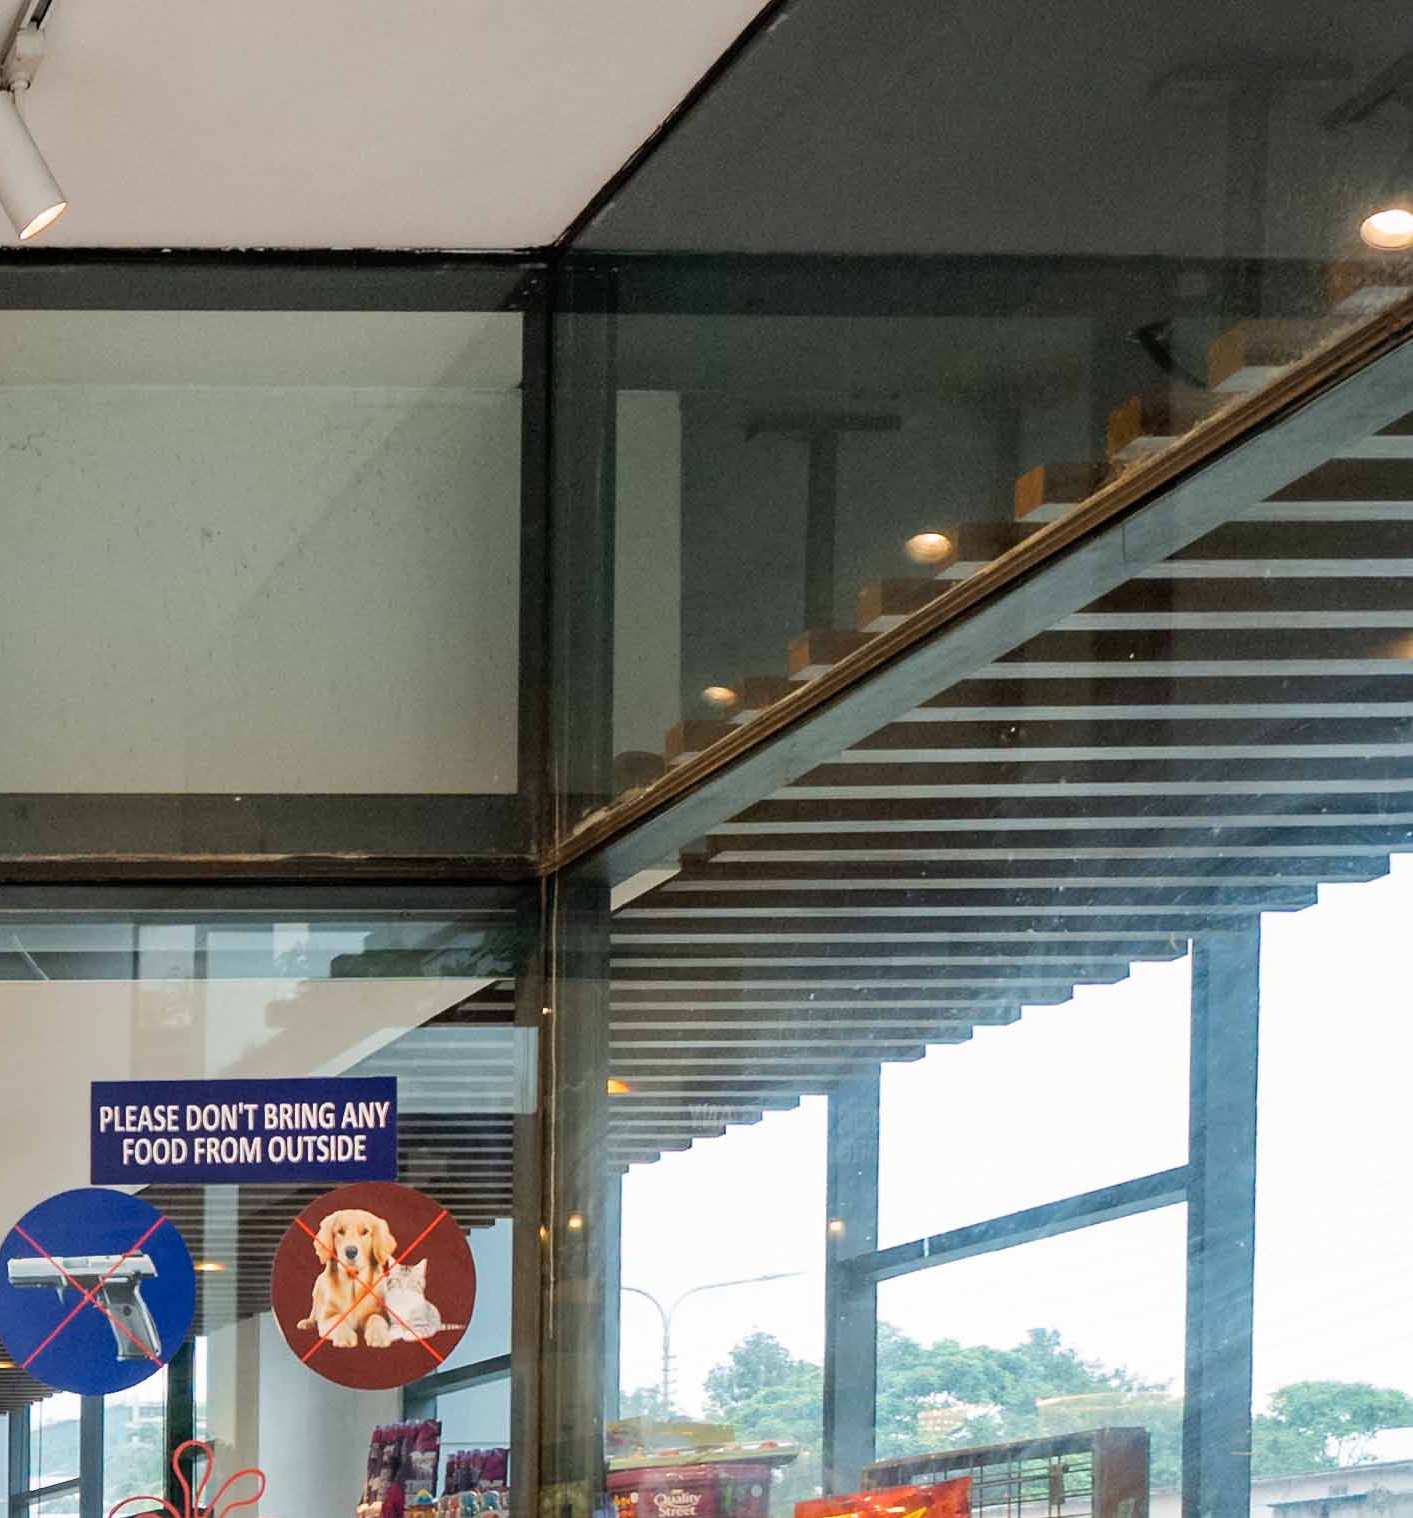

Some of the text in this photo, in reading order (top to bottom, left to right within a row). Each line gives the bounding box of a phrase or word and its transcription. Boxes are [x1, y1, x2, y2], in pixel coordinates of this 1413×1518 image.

[99, 1101, 390, 1133] PLEASE DON'T BRING ANY
[122, 1133, 367, 1166] FOOD FROM OUTSIDE
[653, 1493, 703, 1510] Quality
[658, 1504, 697, 1518] Street
